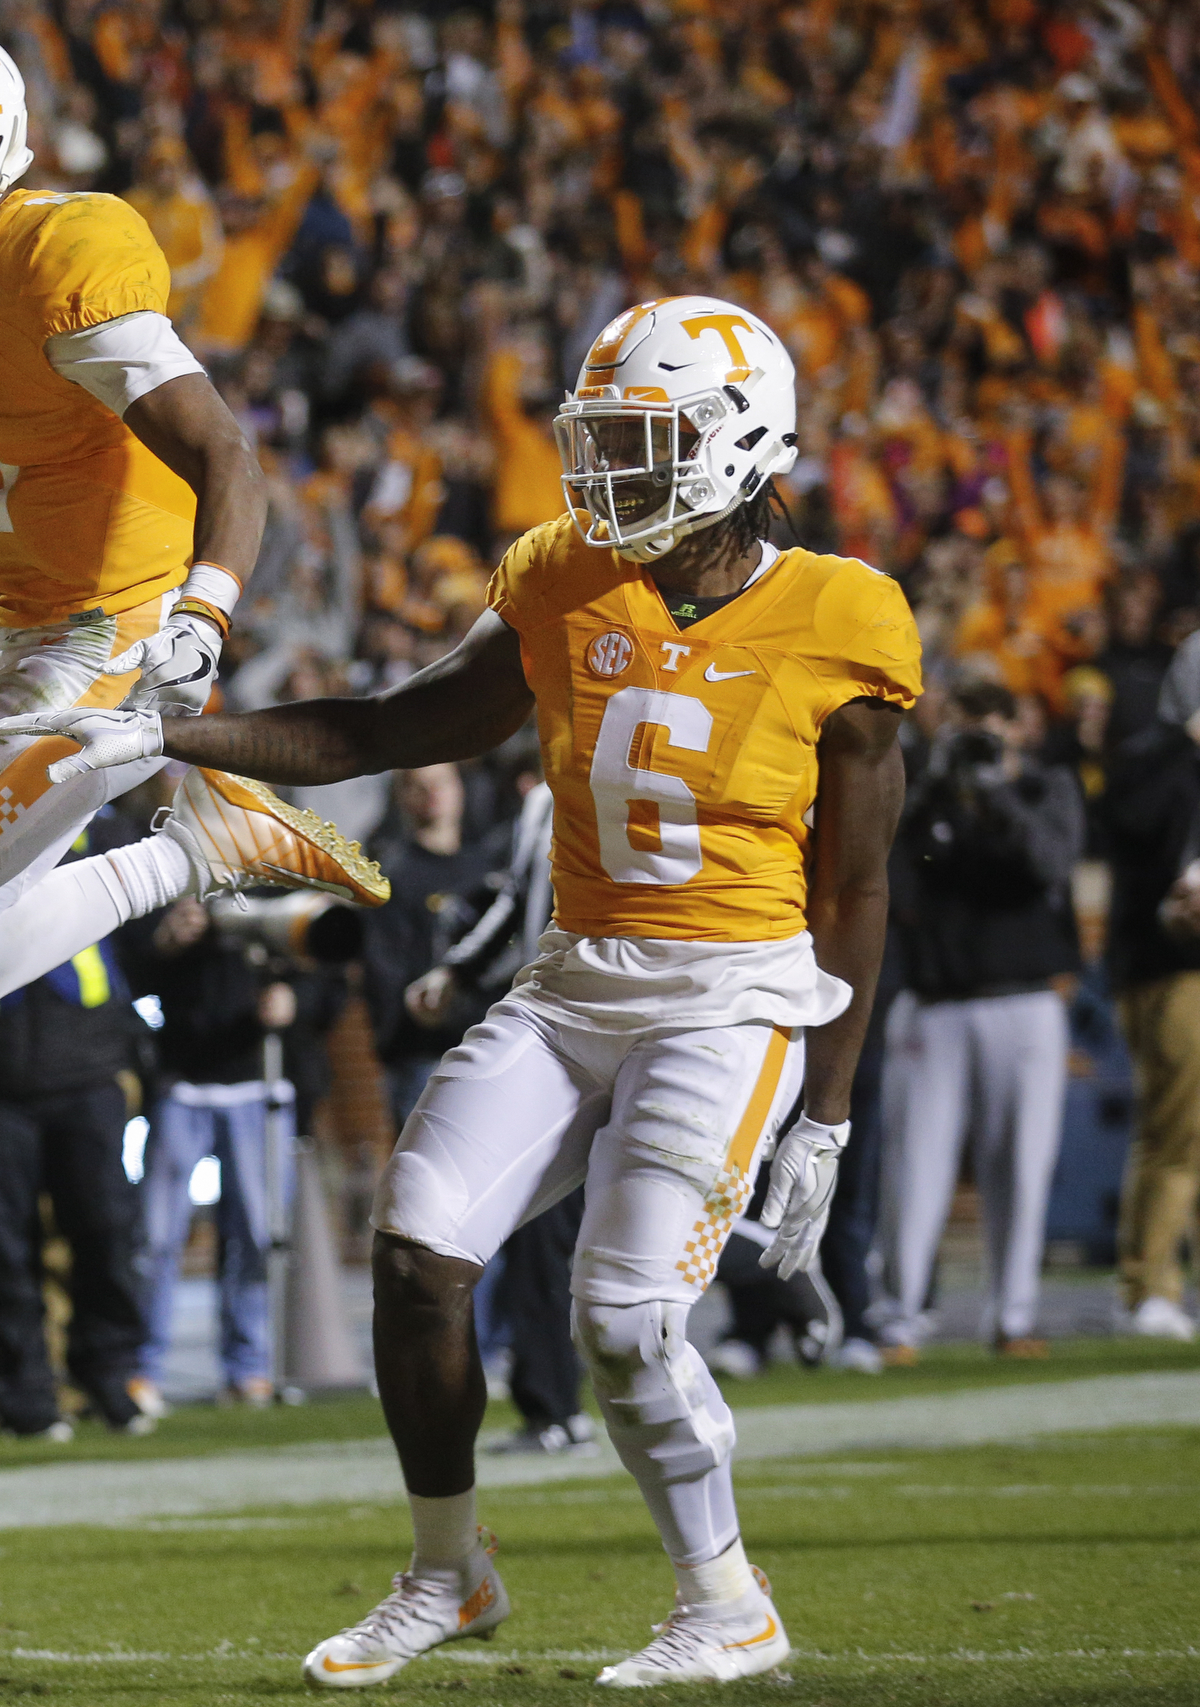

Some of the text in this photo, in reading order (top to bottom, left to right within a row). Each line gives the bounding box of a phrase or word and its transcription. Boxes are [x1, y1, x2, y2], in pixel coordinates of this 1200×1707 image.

[679, 314, 754, 383] T
[591, 633, 631, 675] SEC
[660, 641, 690, 672] T
[589, 685, 714, 885] 6
